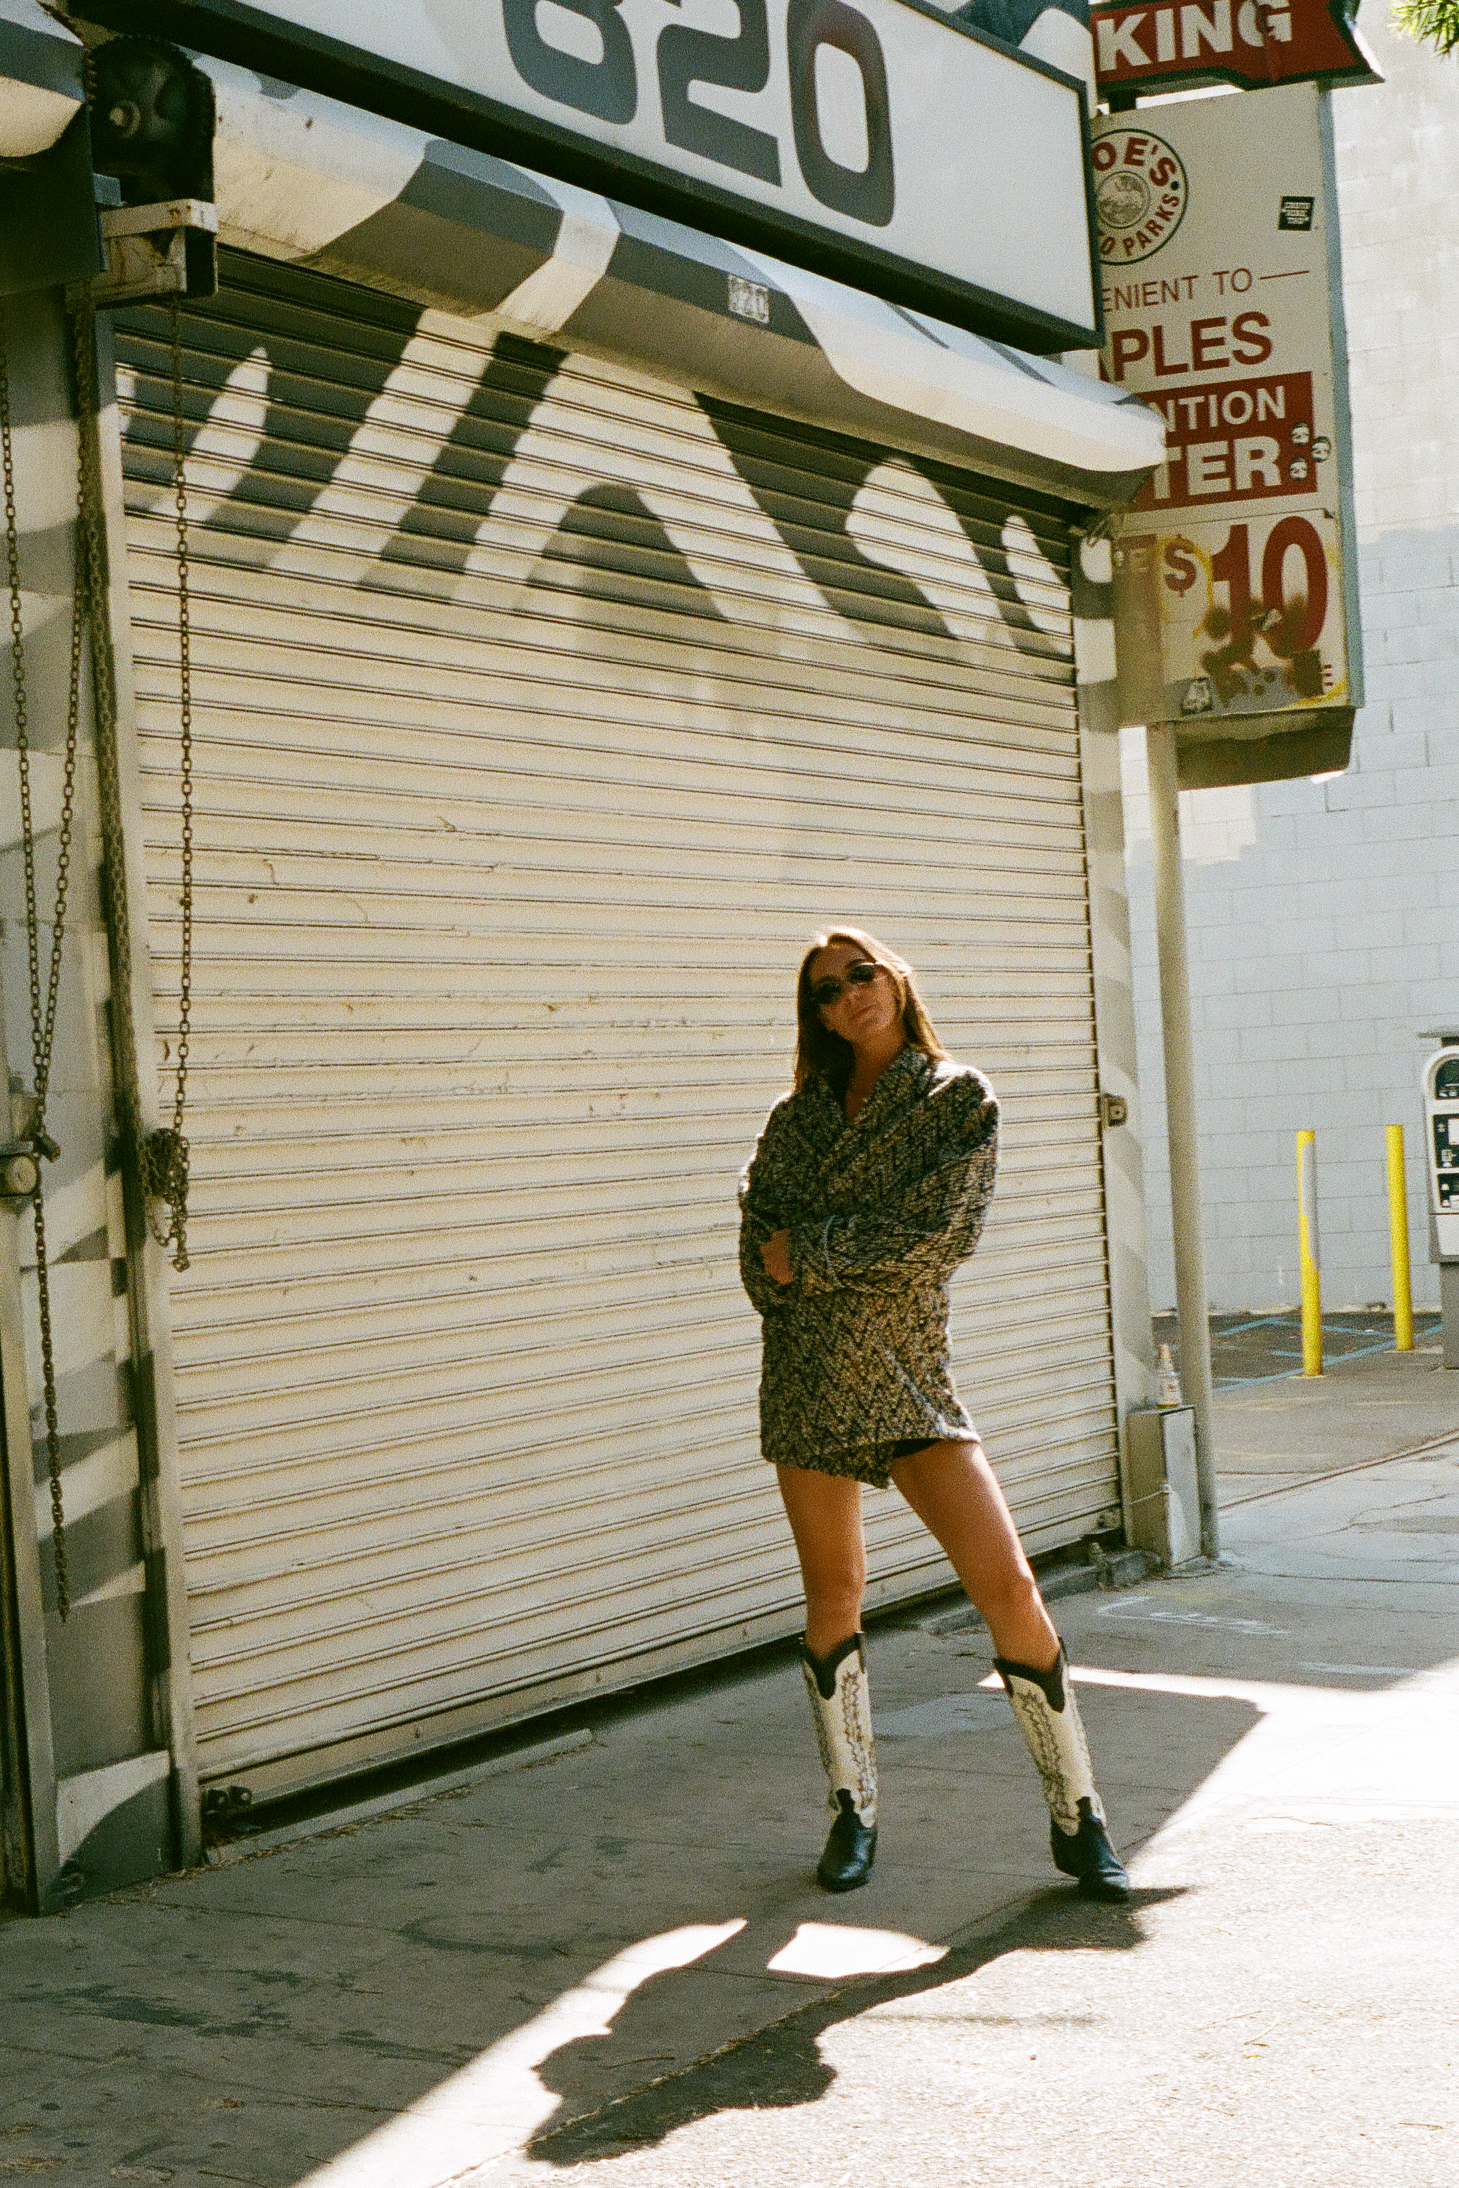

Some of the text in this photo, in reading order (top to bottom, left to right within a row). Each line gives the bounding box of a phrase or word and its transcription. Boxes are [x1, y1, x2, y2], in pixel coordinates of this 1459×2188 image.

[1096, 0, 1293, 72] KING
[1122, 193, 1180, 257] PARKS
[1102, 267, 1253, 312] ENIENT TO
[1099, 311, 1273, 382] PLES
[1150, 385, 1286, 433] NTION
